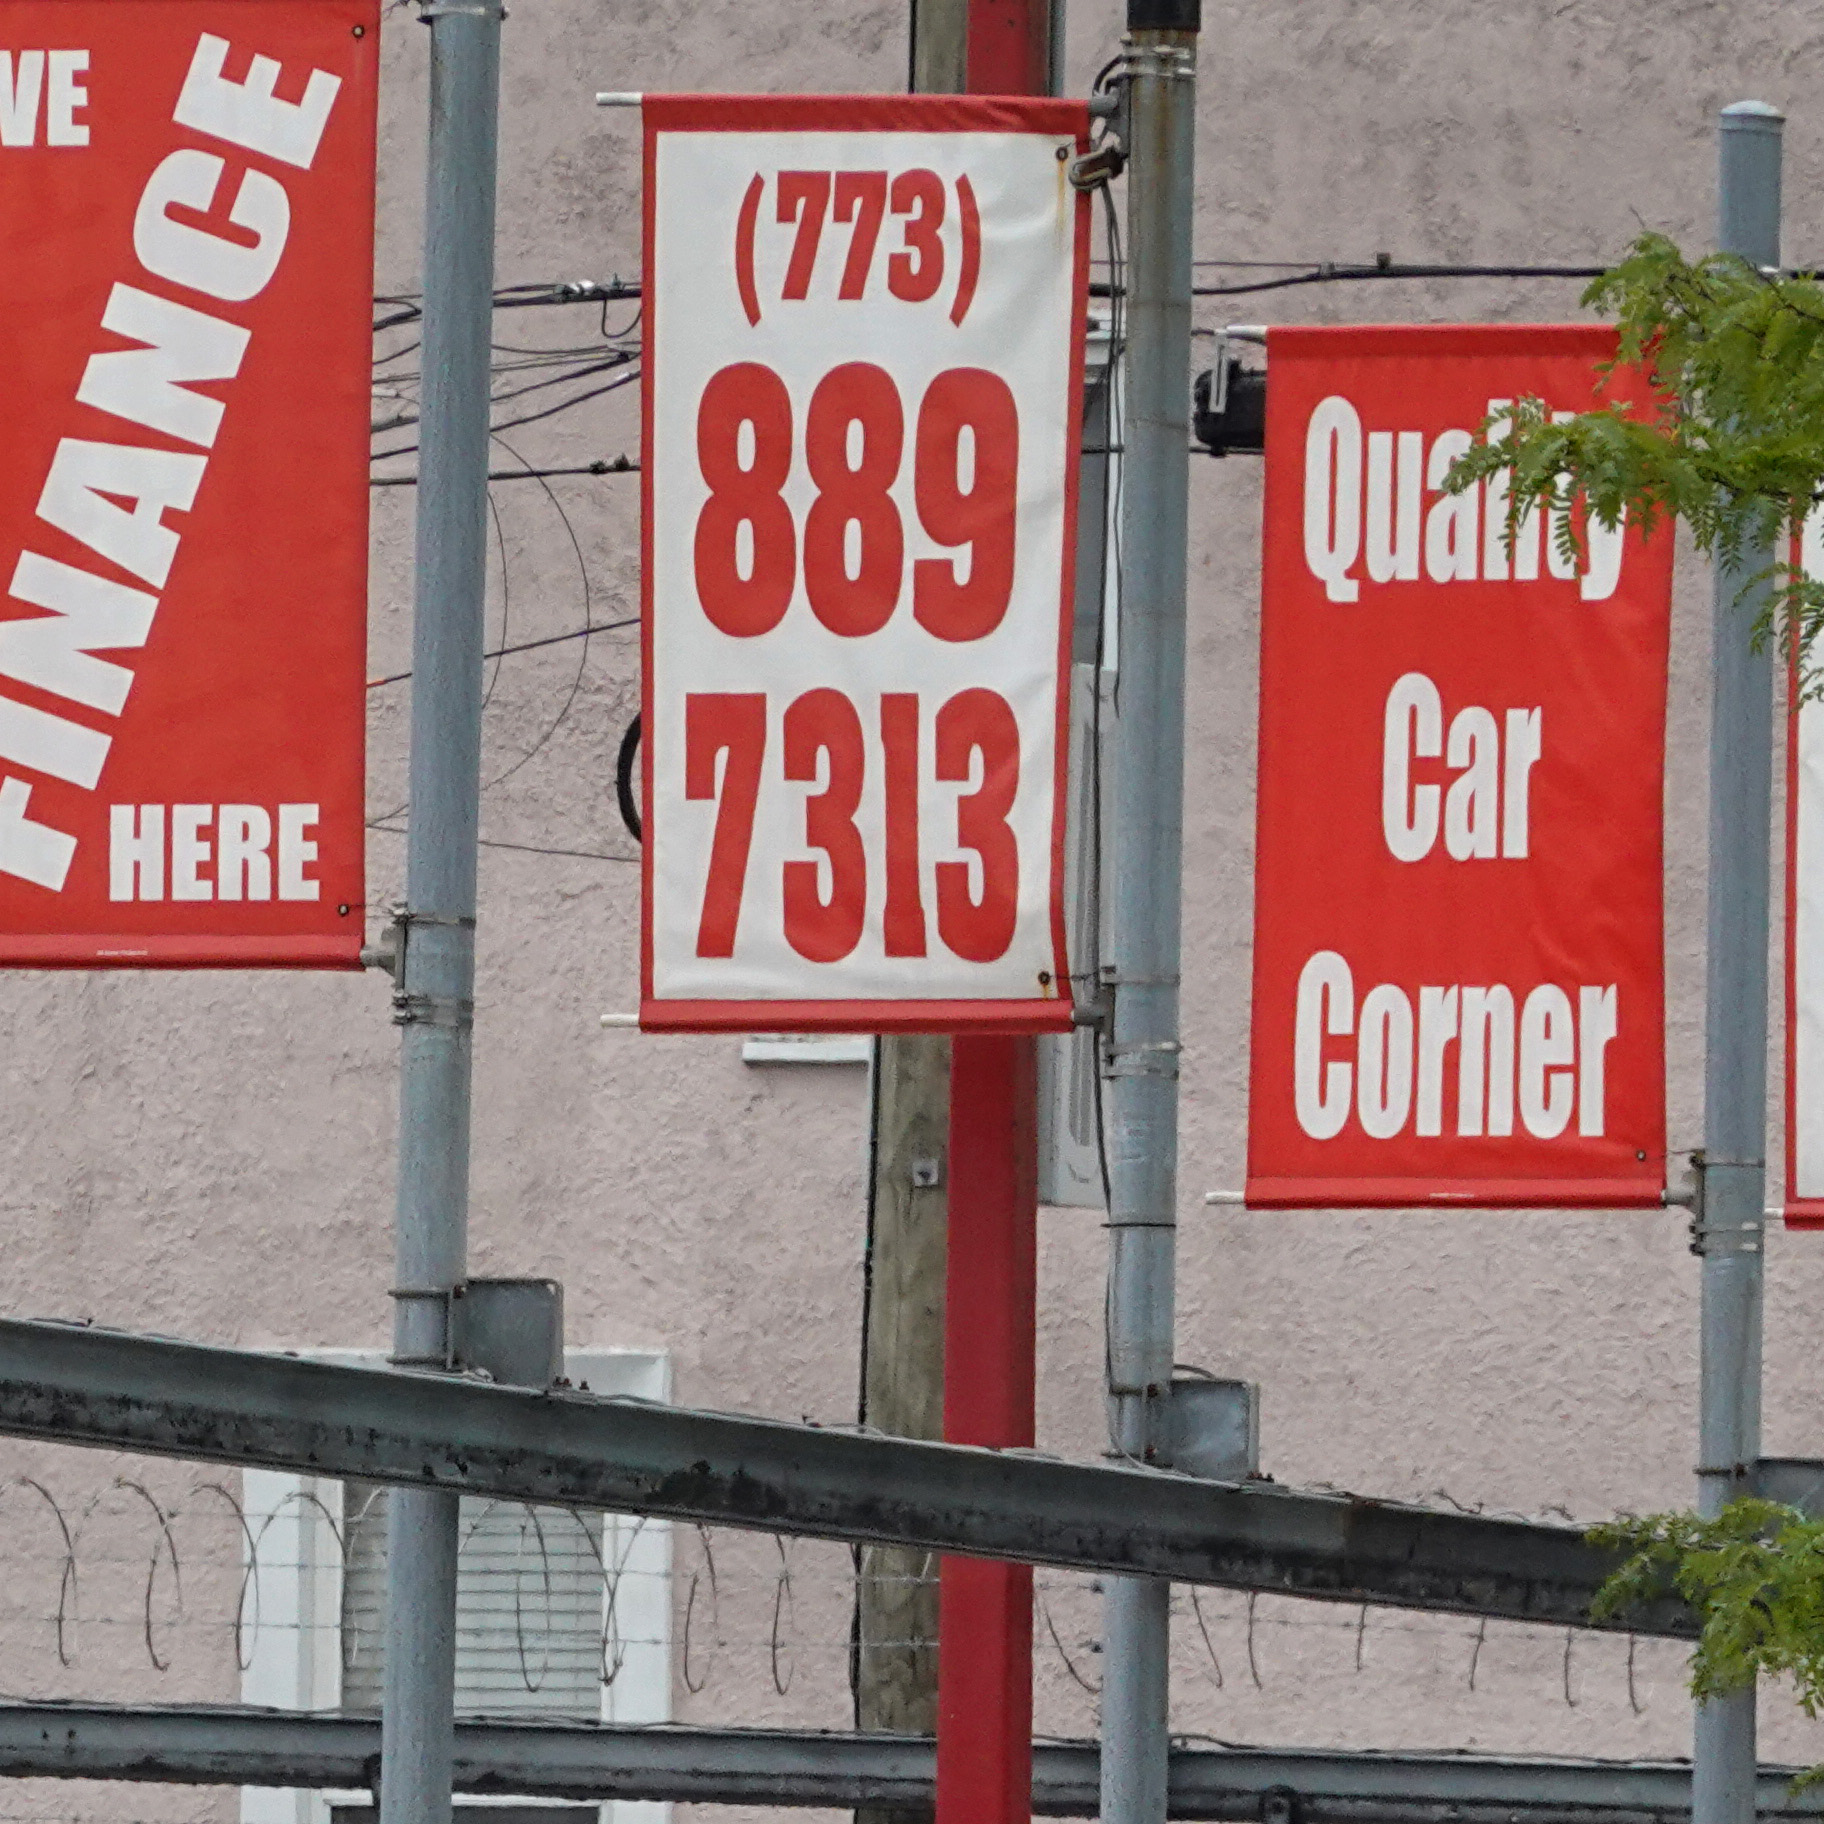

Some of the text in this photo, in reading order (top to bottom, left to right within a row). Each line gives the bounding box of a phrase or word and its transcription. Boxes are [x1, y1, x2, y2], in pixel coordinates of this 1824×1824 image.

[735, 168, 981, 327] (773)
[694, 361, 1020, 642] 889
[108, 804, 320, 902] HERE
[685, 686, 1021, 963] 7313
[1382, 672, 1542, 863] Car
[1294, 950, 1618, 1141] Corner
